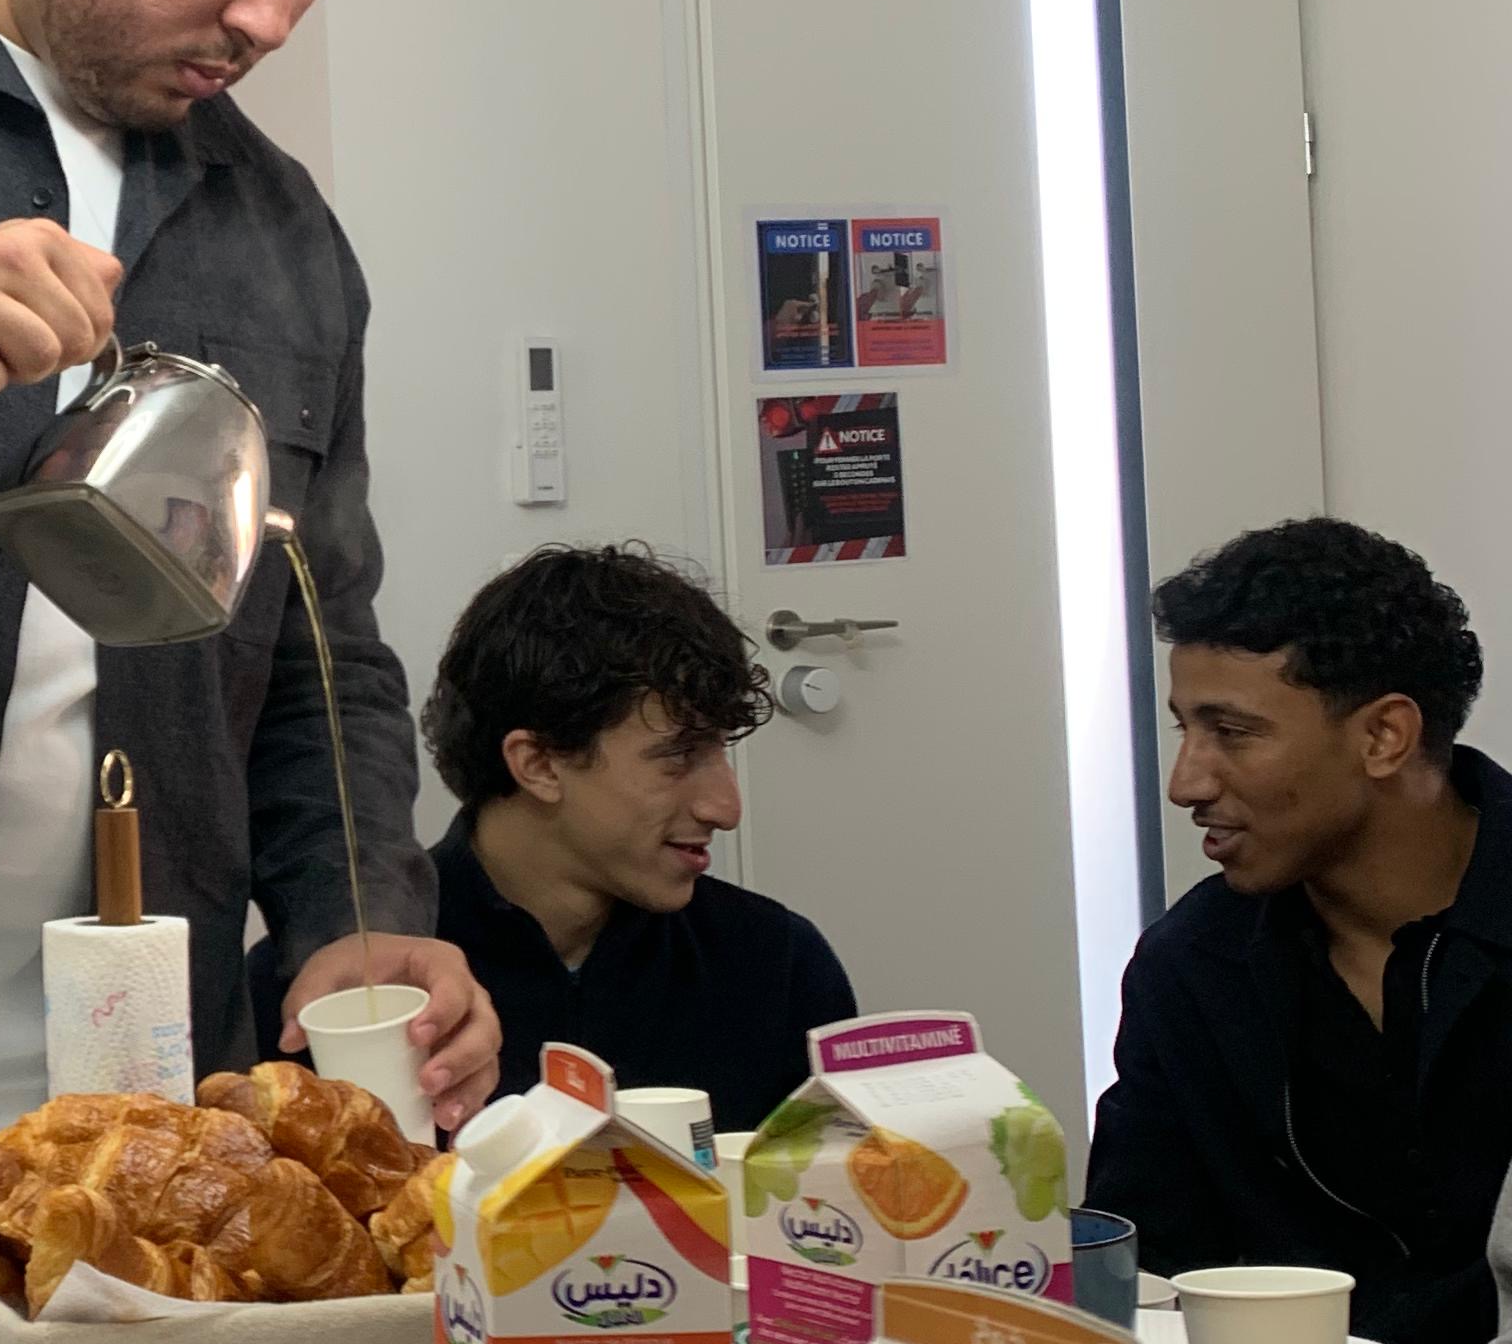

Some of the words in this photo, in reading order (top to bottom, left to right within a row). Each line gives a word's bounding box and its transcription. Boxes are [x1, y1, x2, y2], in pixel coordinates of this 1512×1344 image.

[775, 234, 831, 248] NOTICE
[870, 232, 923, 247] NOTICE
[839, 428, 886, 444] NOTICE
[832, 1025, 964, 1061] MULTIVITAMINÉ
[788, 1217, 854, 1247] دليس
[565, 1272, 664, 1307] دليس
